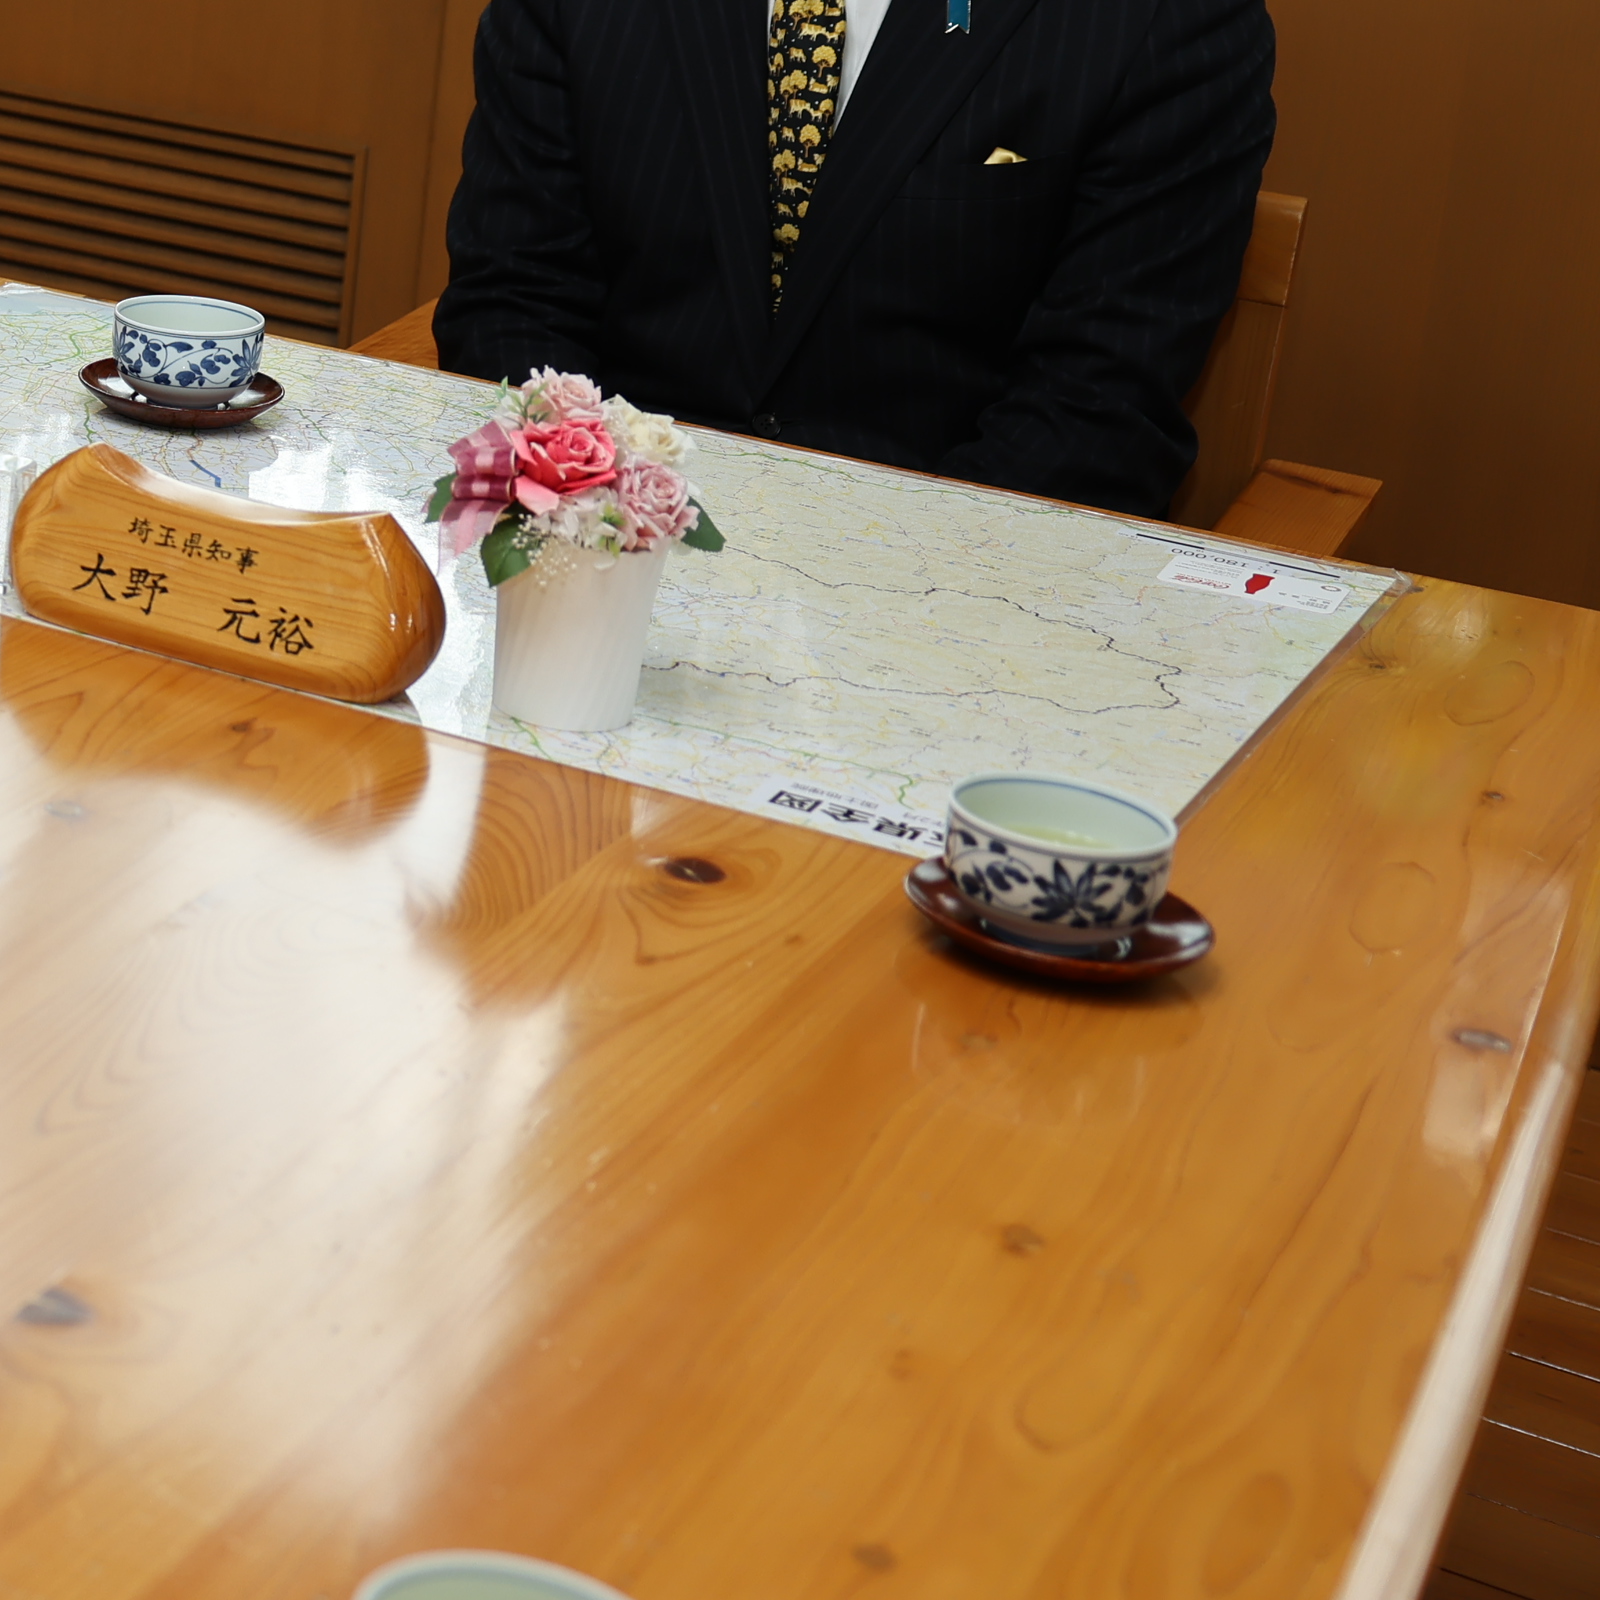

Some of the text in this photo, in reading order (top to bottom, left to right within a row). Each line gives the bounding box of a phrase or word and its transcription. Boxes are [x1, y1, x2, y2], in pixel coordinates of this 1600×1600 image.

[128, 516, 260, 575] 埼玉県知事
[72, 552, 315, 657] 大野 元裕
